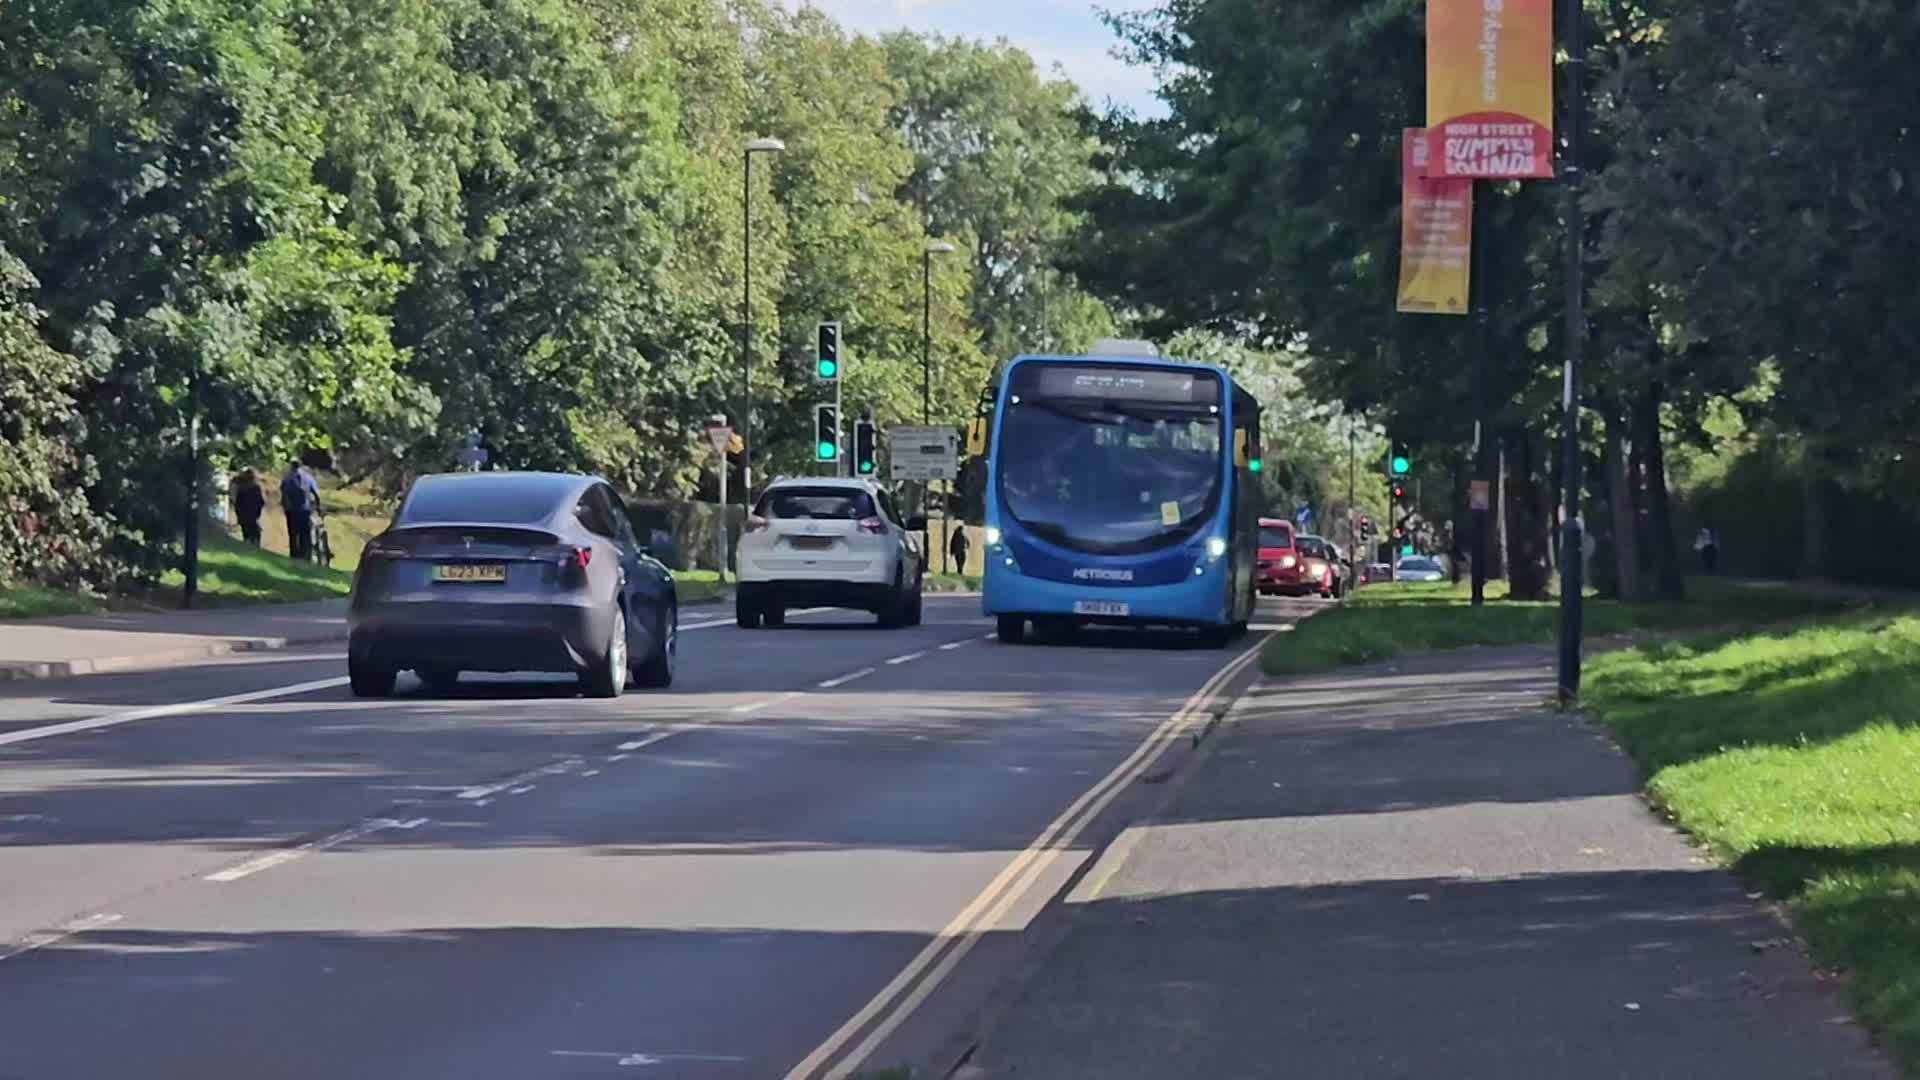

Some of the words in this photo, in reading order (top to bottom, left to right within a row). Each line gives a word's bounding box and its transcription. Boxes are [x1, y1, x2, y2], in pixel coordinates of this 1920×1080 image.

[1445, 124, 1478, 136] HIGH
[1482, 124, 1535, 136] STREET
[1073, 568, 1133, 581] METROBUS
